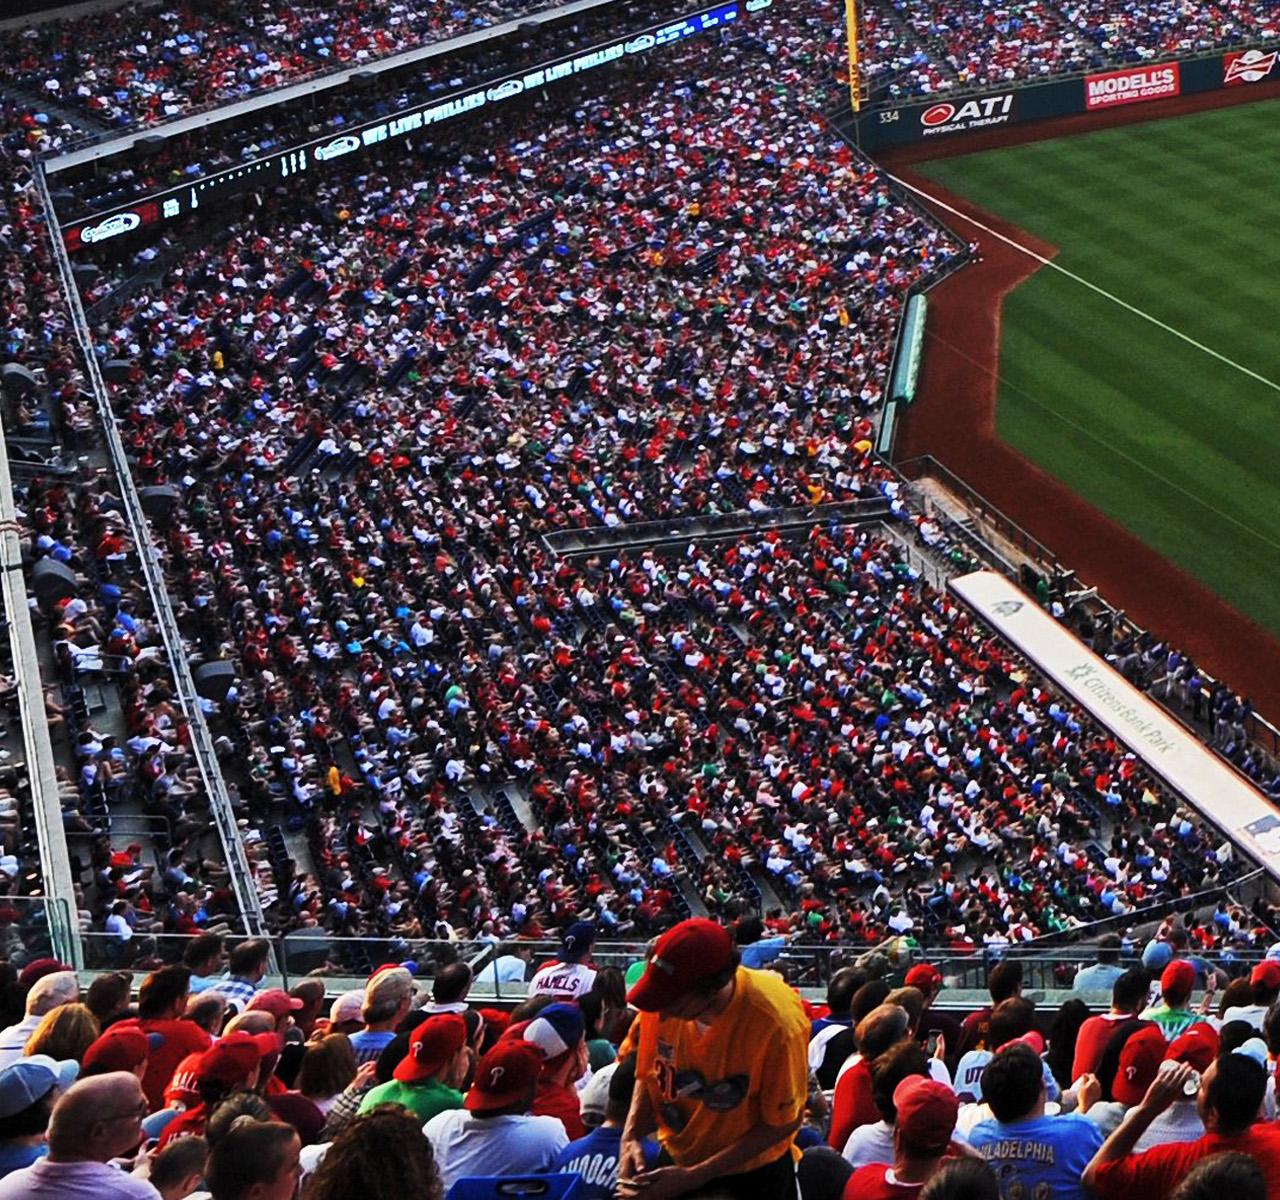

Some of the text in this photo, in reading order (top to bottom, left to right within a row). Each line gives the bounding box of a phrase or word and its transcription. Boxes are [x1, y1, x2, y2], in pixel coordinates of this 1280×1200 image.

[1088, 68, 1175, 97] MODELL'S
[1089, 83, 1175, 105] SPORTING GOODS
[952, 94, 1013, 122] ATI
[922, 114, 1009, 136] PHYSICAL THERAPY
[1084, 677, 1176, 754] Citizens Bank Park
[536, 974, 580, 992] HAMELS
[560, 1153, 620, 1189] HOOC
